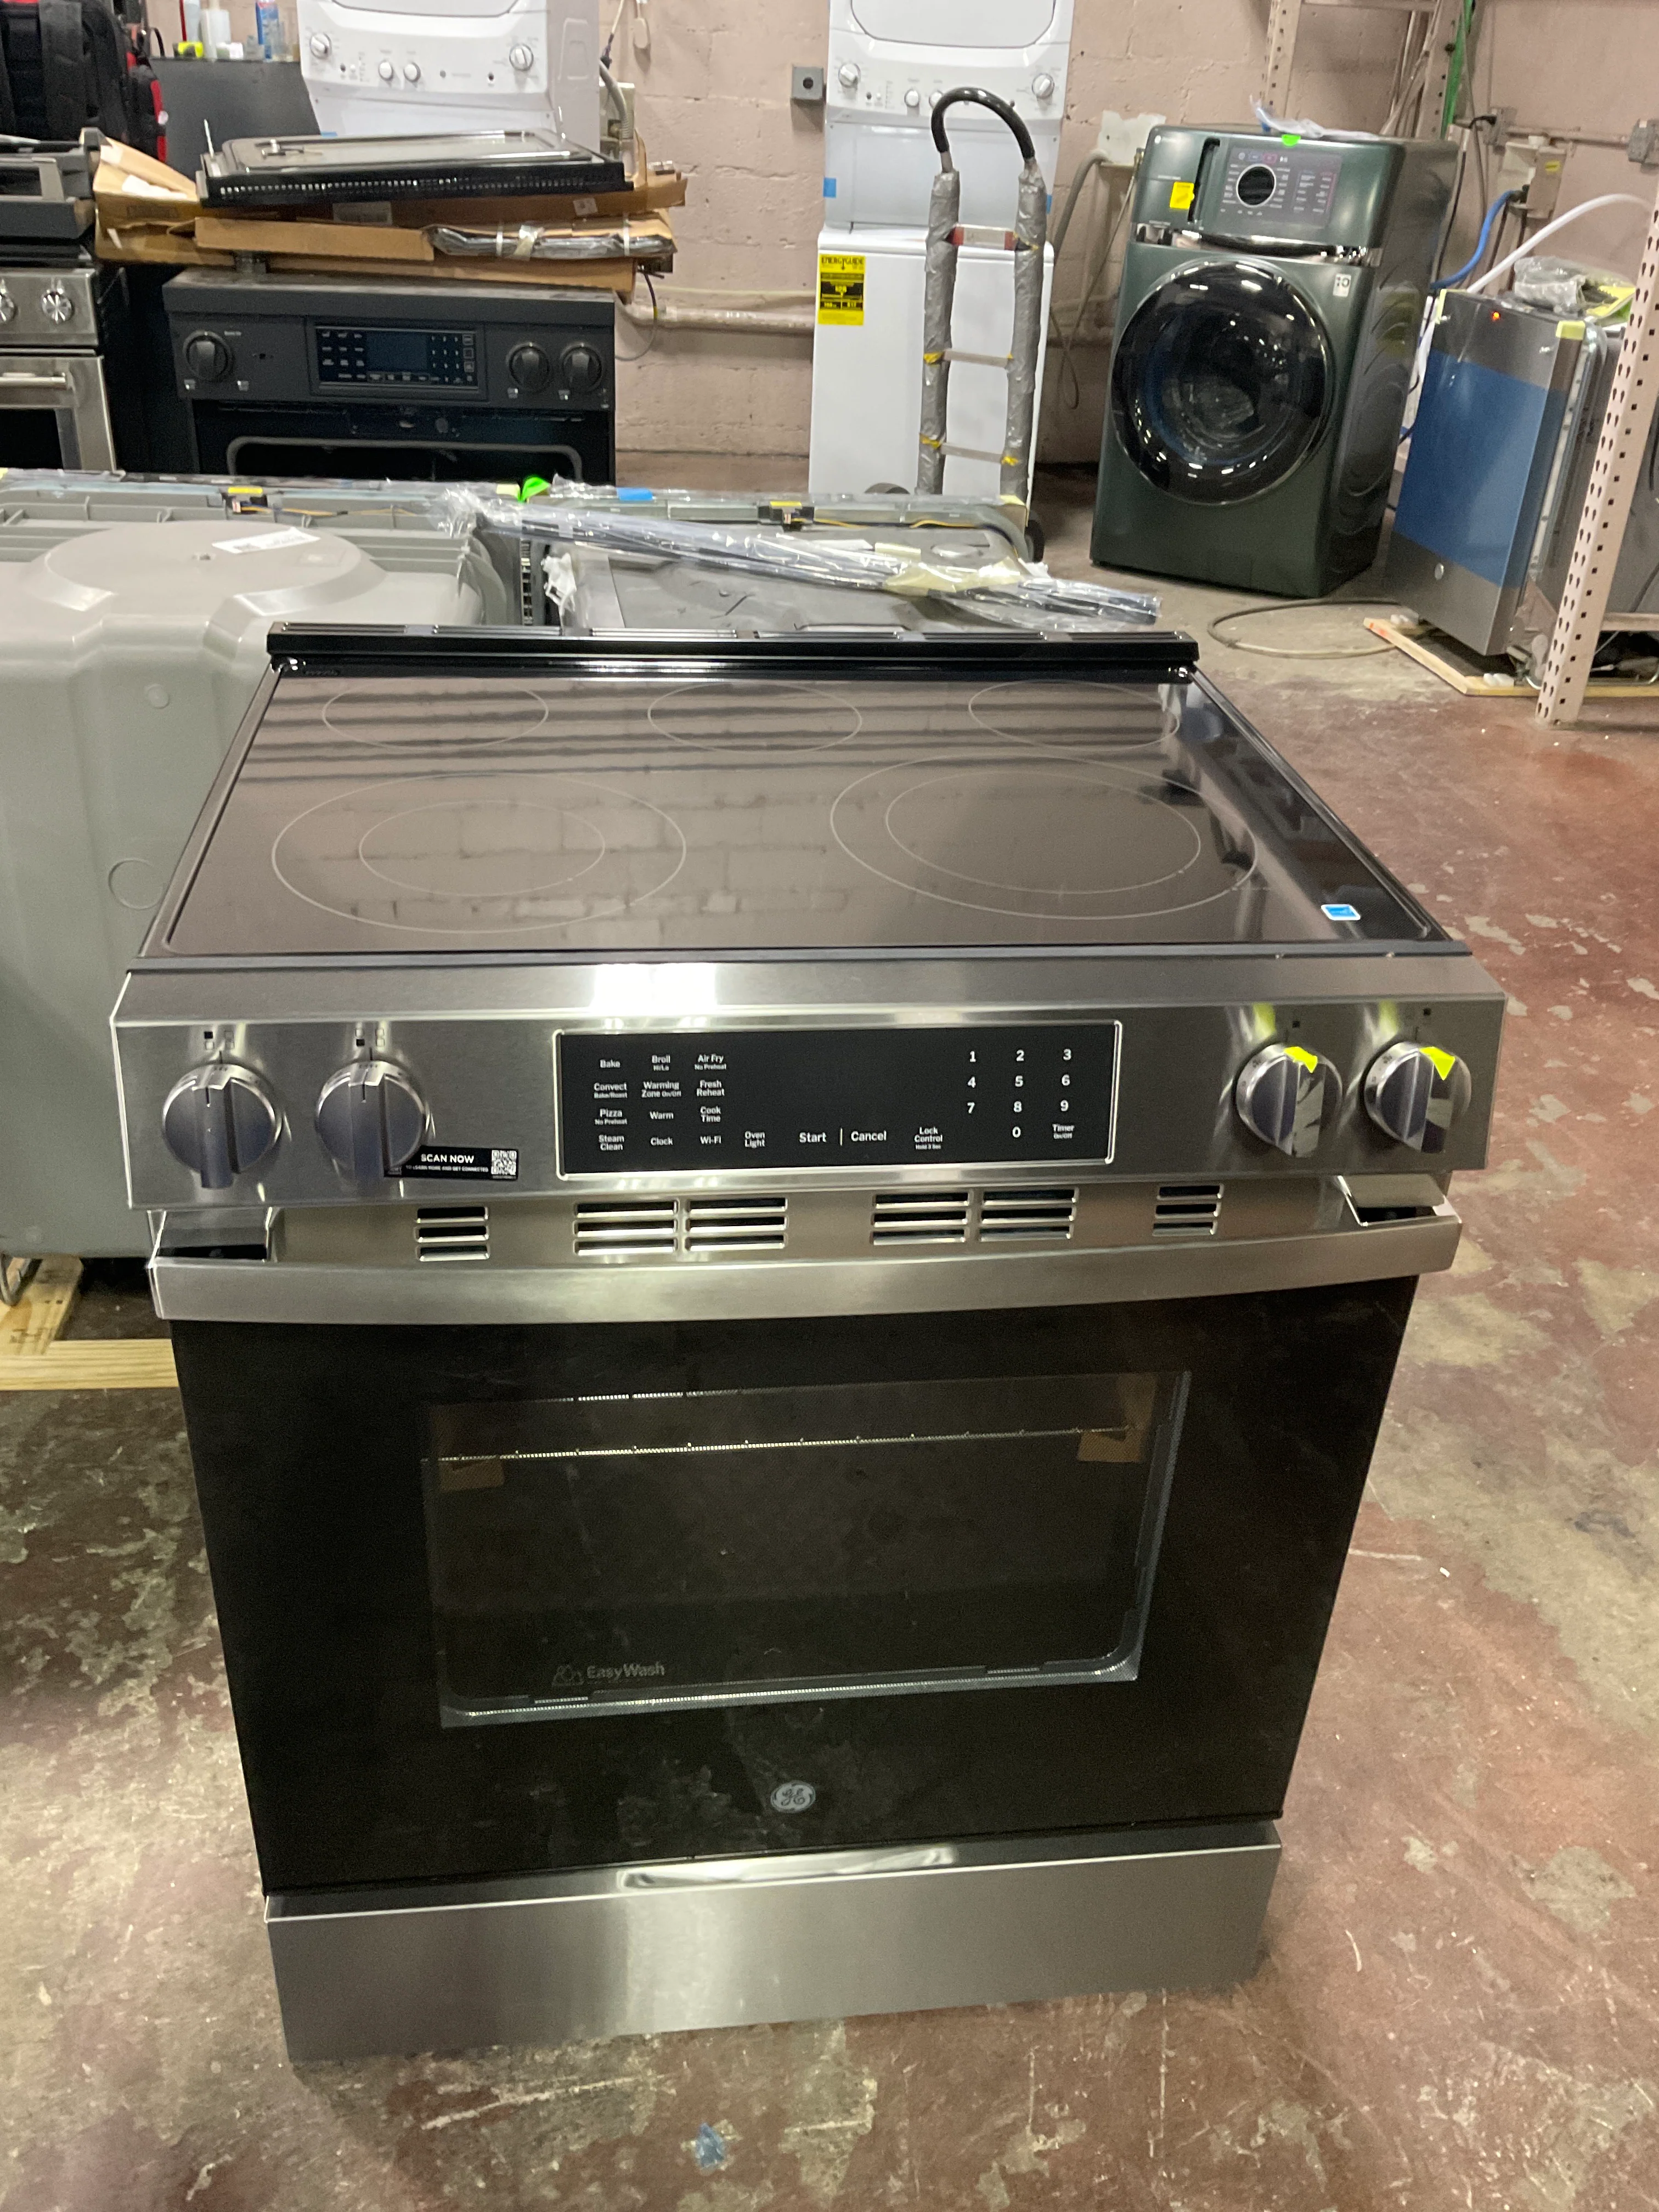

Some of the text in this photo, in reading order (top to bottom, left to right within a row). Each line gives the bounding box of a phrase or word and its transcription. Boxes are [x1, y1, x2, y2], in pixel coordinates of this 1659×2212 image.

[651, 1054, 670, 1063] Broil
[698, 1053, 724, 1064] Air Fry
[969, 1051, 976, 1062] 1
[1016, 1049, 1025, 1062] 2
[1063, 1048, 1071, 1060] 3
[600, 1059, 620, 1068] Bake
[700, 1080, 722, 1088] Fresh
[967, 1076, 977, 1088] 4
[1015, 1075, 1023, 1087] 5
[1062, 1074, 1070, 1086] 6
[594, 1082, 627, 1091] Convect
[643, 1081, 680, 1090] Warming
[641, 1089, 661, 1098] Zone
[696, 1088, 725, 1097] Reheat
[700, 1105, 721, 1114] Cook
[967, 1102, 975, 1114] 7
[1013, 1101, 1022, 1113] 8
[1060, 1099, 1069, 1111] 9
[600, 1108, 623, 1118] Pizza
[650, 1111, 674, 1120] Warm
[701, 1114, 721, 1122] Time
[919, 1126, 938, 1135] Lock
[1012, 1126, 1021, 1138] 0
[1052, 1124, 1075, 1132] Timer
[599, 1135, 624, 1143] Steam
[700, 1135, 721, 1144] Wi-Fi
[744, 1131, 765, 1139] Oven
[799, 1132, 827, 1143] Start
[851, 1130, 887, 1142] Cancel
[914, 1135, 943, 1143] Control
[650, 1137, 673, 1146] Clock
[744, 1139, 765, 1148] Light
[421, 1154, 474, 1164] SCAN NOW
[586, 1661, 665, 1681] EasyWash
